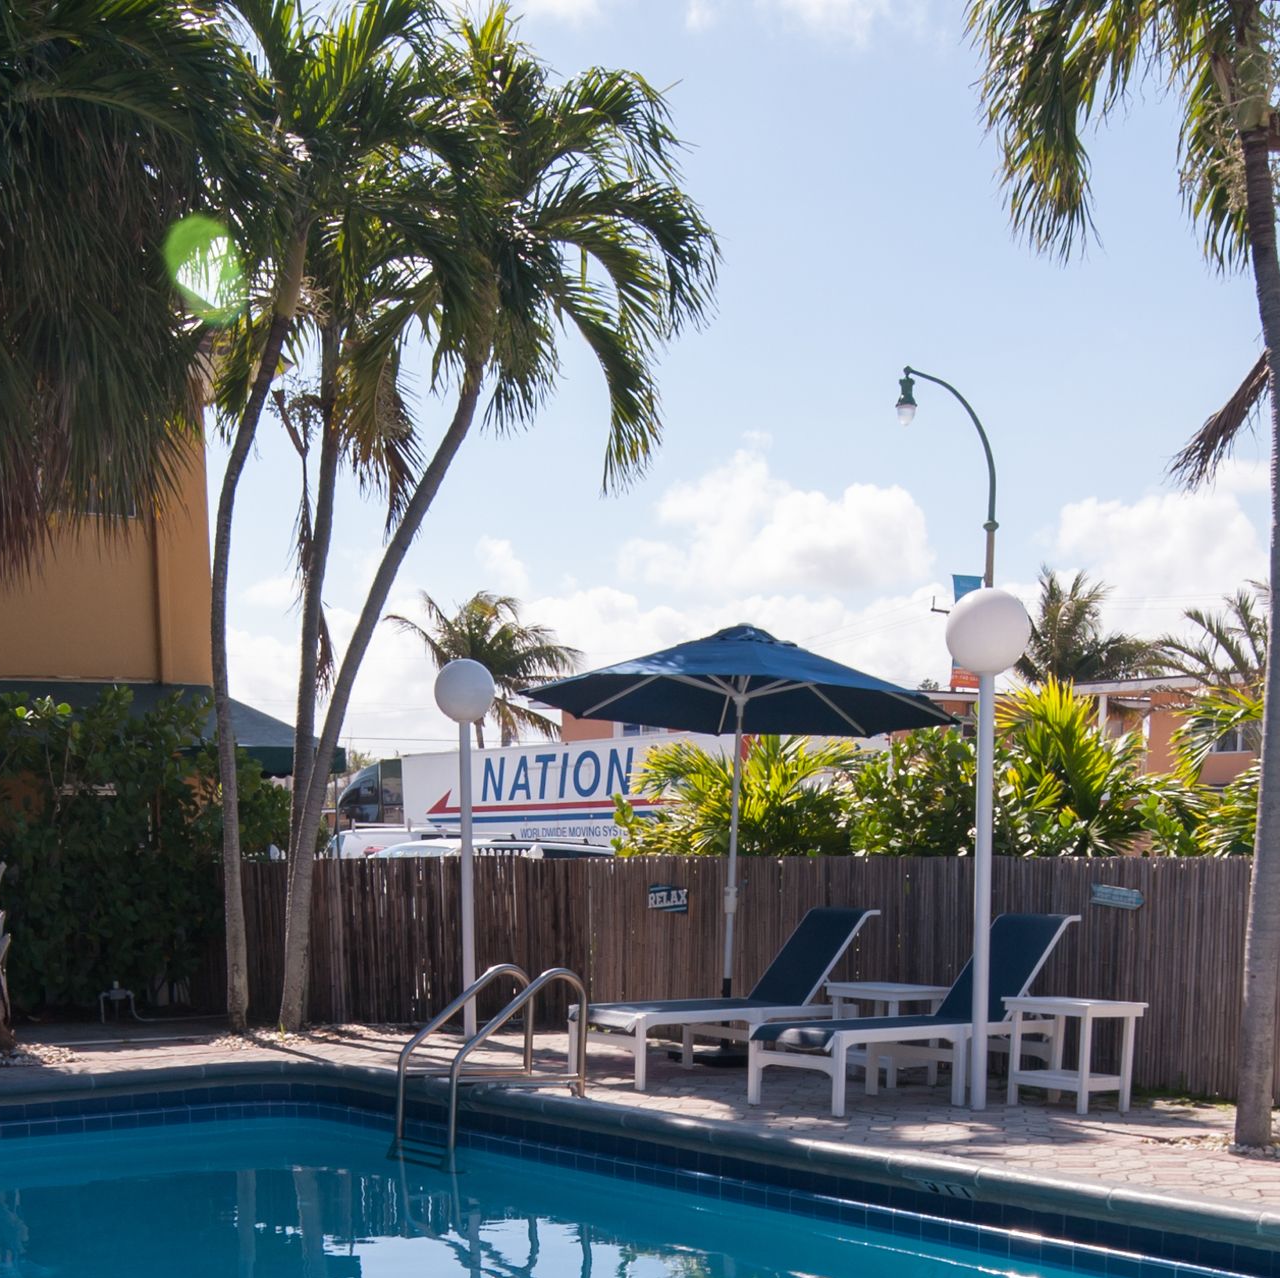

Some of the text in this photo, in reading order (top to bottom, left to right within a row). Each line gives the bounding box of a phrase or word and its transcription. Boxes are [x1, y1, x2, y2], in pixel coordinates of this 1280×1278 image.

[481, 747, 635, 802] NATION
[521, 827, 568, 839] WORLDWIDE
[569, 825, 601, 838] MOVING
[648, 889, 688, 908] RELAX
